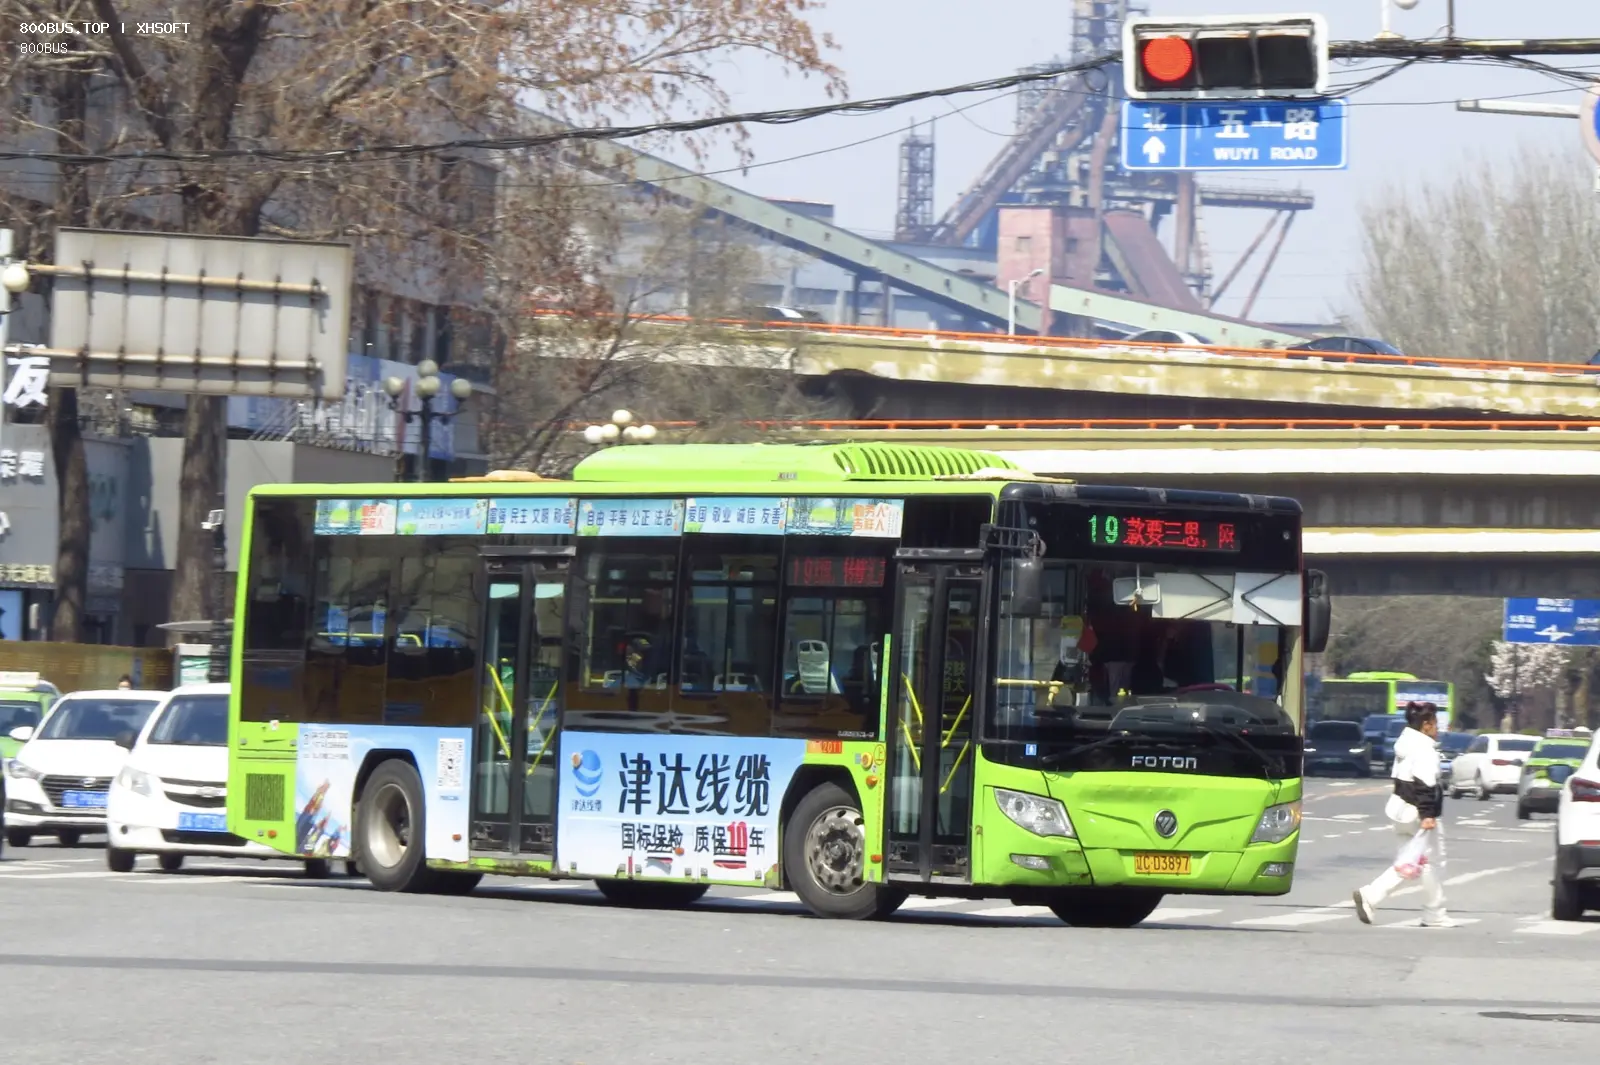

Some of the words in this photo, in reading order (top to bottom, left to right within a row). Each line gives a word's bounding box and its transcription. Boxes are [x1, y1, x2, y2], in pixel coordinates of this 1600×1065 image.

[1142, 108, 1168, 131] 北
[1215, 108, 1320, 140] 五一路
[1213, 147, 1259, 160] WUYI
[1270, 146, 1318, 160] ROAD
[587, 510, 605, 526] 自由
[609, 509, 628, 526] 平等
[632, 509, 651, 526] 公正
[688, 506, 707, 523] 爱国
[762, 507, 782, 525] 友善
[1088, 514, 1119, 544] 19
[1131, 755, 1198, 769] FOTON
[618, 752, 772, 817] 津达线缆
